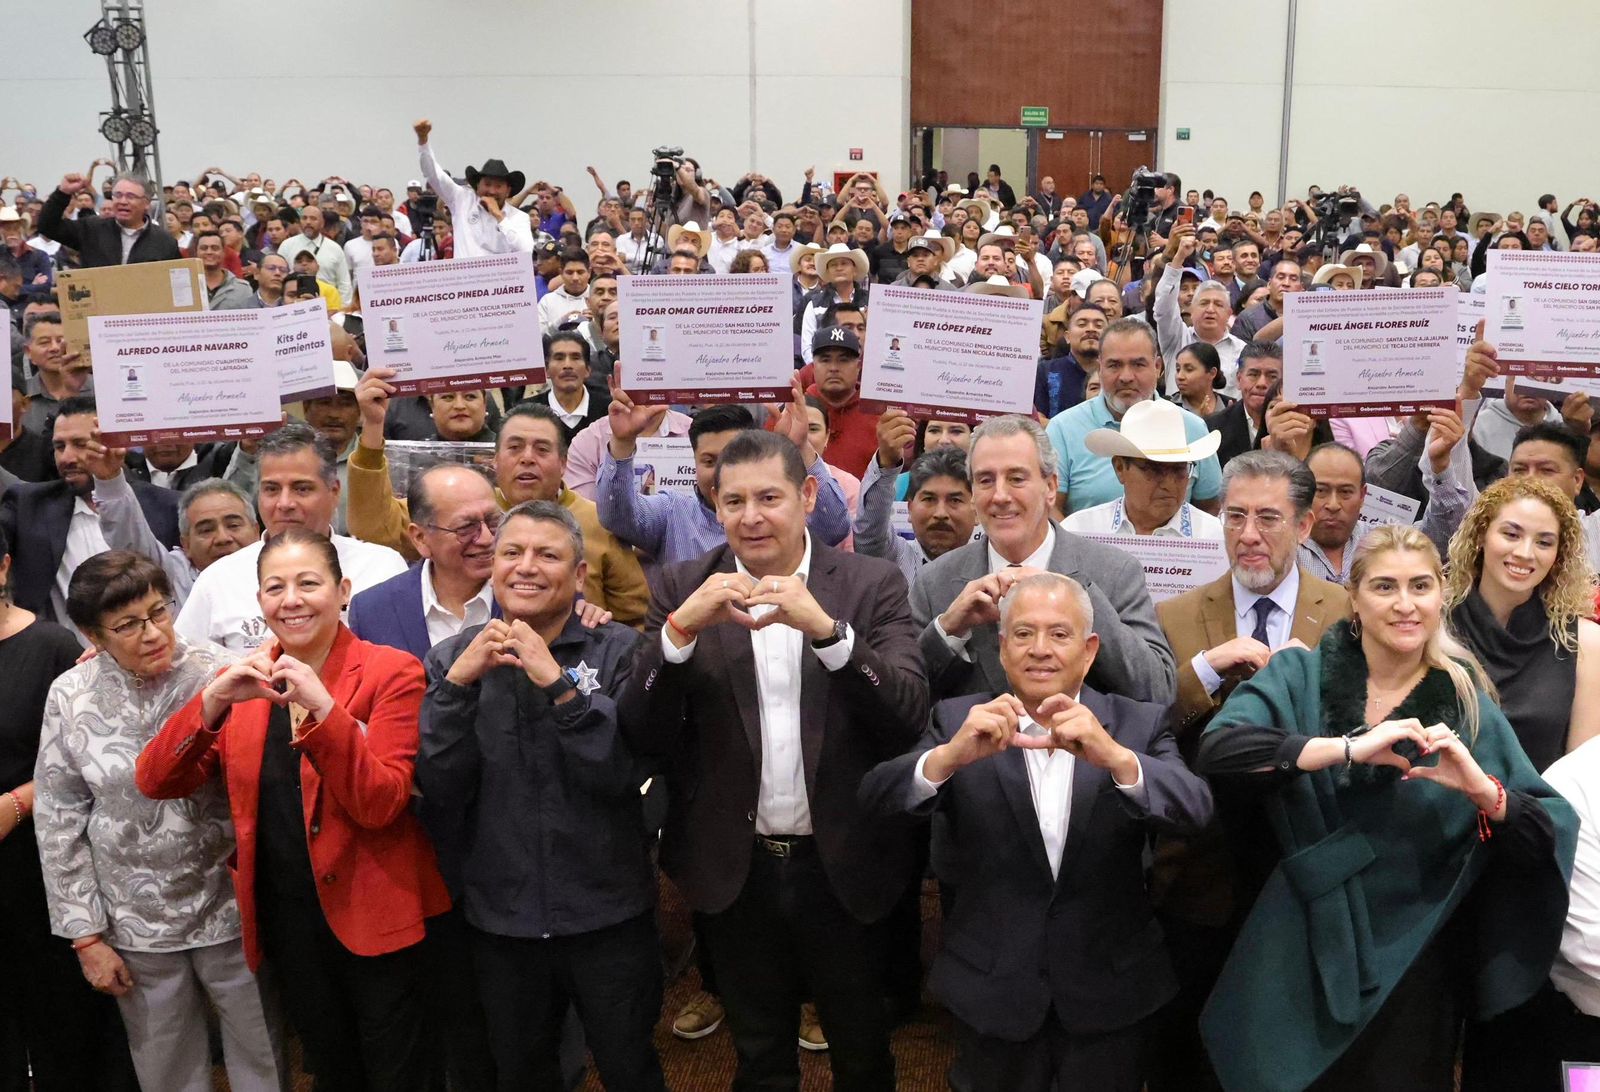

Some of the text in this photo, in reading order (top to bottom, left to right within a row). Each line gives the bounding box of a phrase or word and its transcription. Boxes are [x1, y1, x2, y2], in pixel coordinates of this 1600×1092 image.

[1524, 281, 1552, 289] TOMÁS
[370, 286, 524, 308] ELADIO FRANCISCO PINEDA JUÁREZ
[697, 305, 744, 314] GUTIÉRREZ
[746, 304, 773, 313] LÓPEZ
[913, 321, 992, 336] EVER LÓPEZ PÉREZ
[1309, 318, 1429, 331] MIGUEL ÁNGEL FLORES RUÍZ
[277, 331, 308, 344] Kits de
[117, 342, 248, 356] ALFREDO AGUILAR NAVARRO
[678, 466, 696, 474] Kits
[1166, 566, 1192, 575] LÓPEZ
